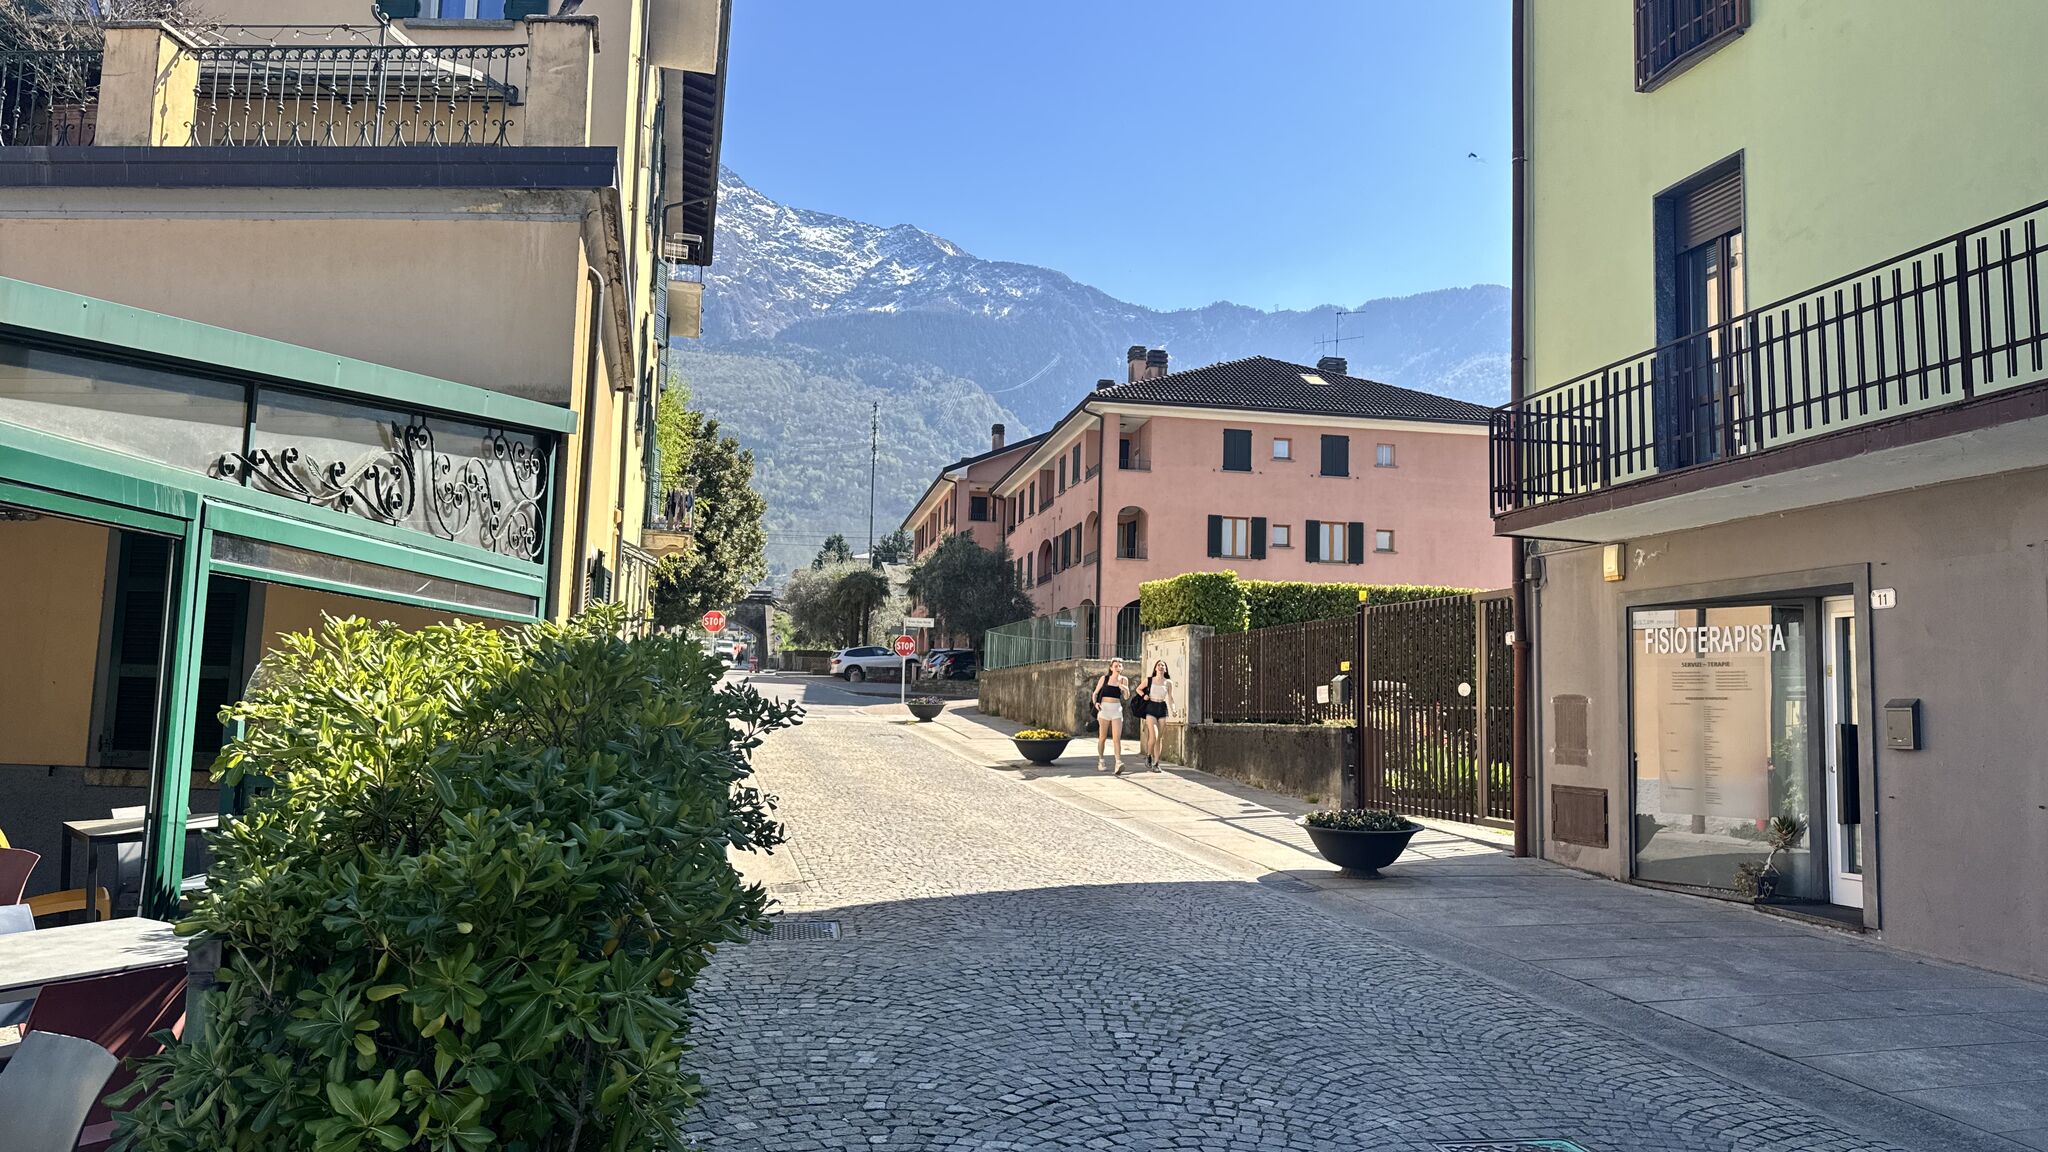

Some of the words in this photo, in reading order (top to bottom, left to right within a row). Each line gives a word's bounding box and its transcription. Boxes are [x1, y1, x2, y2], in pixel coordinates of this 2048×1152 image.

[1878, 593, 1887, 606] 11
[704, 617, 724, 626] STOP
[1645, 623, 1786, 654] FISIOTERAPISTA
[896, 641, 914, 651] STOP
